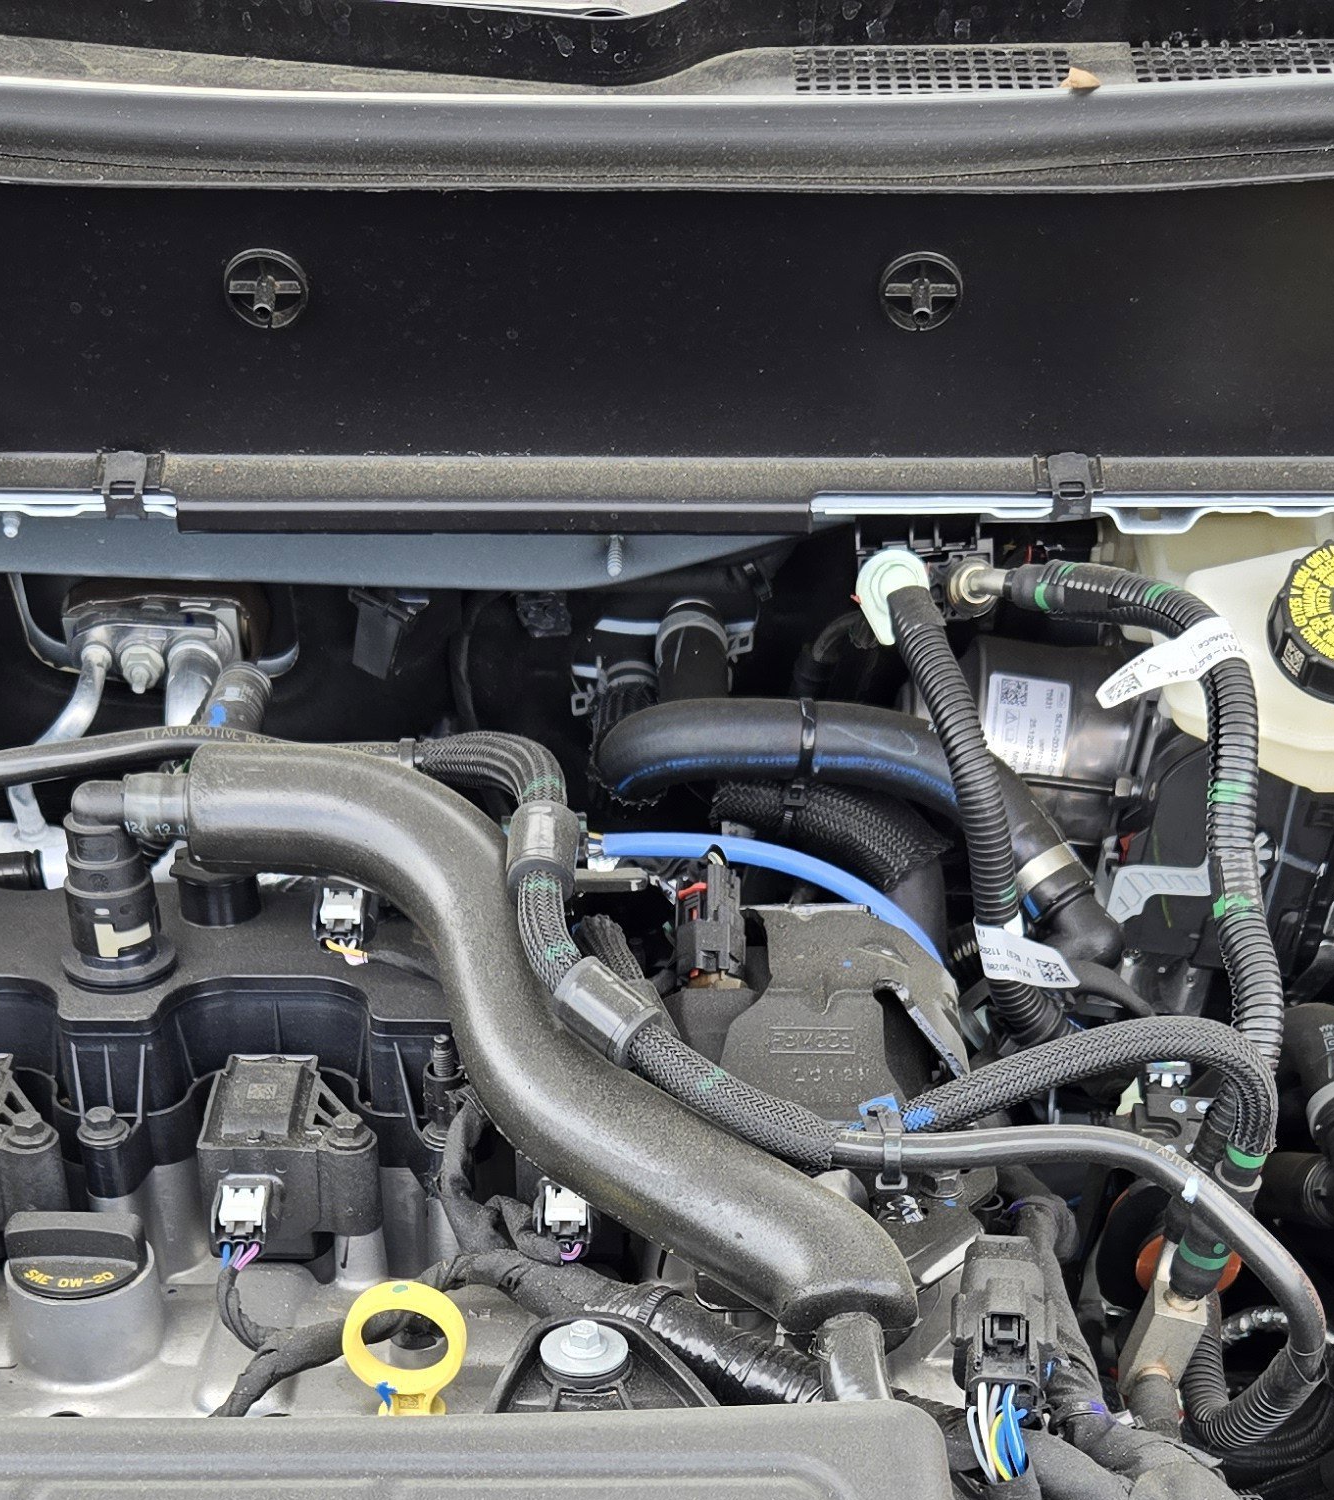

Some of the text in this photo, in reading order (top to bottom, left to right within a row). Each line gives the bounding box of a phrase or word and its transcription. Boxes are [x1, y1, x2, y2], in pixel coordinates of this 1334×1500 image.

[161, 727, 239, 742] AUTOMOTIVE
[25, 1269, 115, 1288] SAE 0W-20
